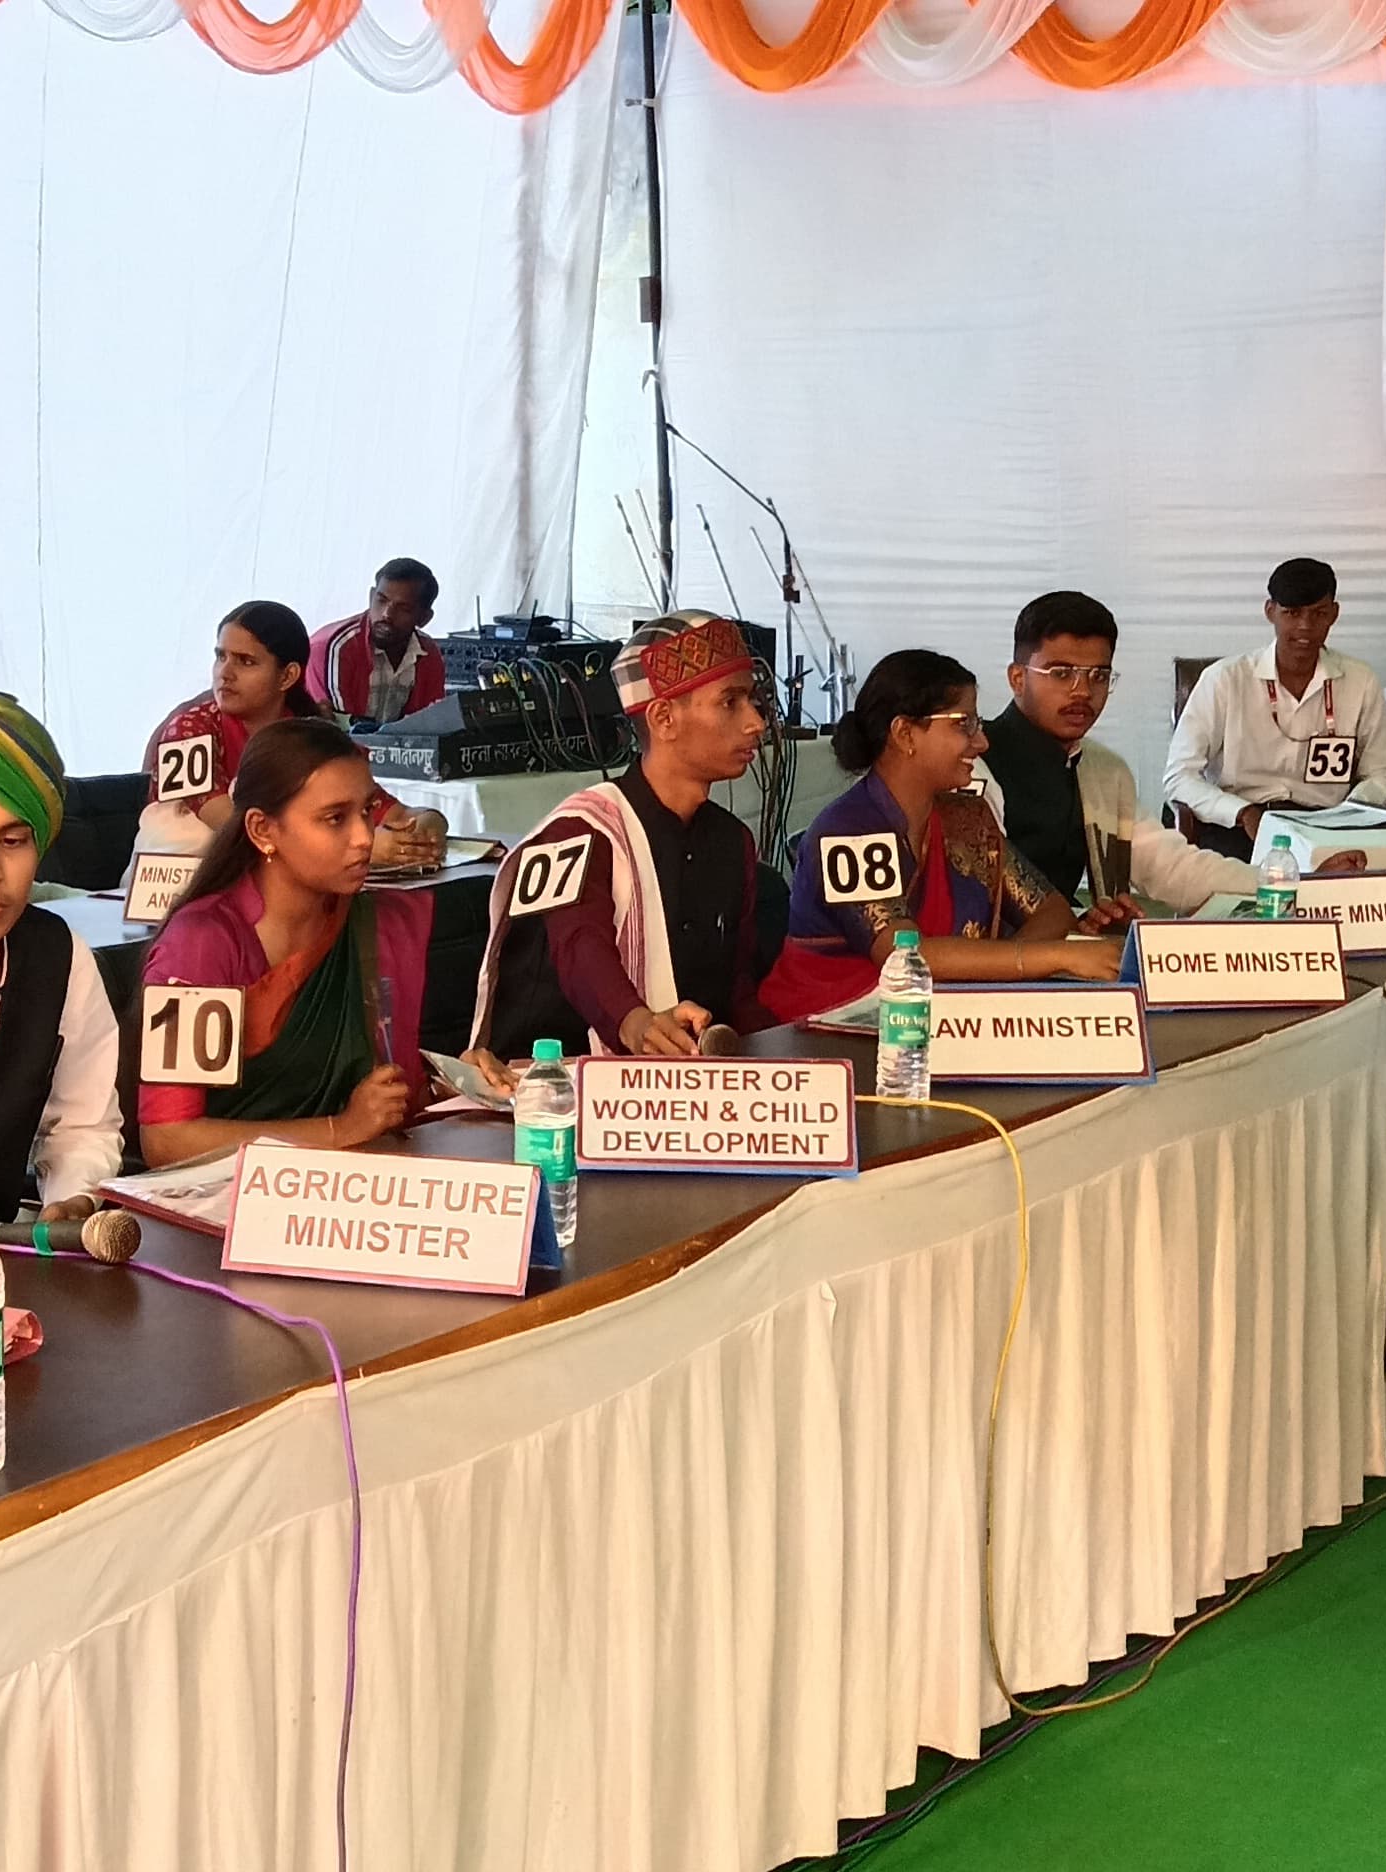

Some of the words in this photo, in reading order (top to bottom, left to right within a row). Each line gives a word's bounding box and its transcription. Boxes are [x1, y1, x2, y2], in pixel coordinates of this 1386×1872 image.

[162, 744, 208, 793] 20
[1310, 743, 1350, 777] 53
[140, 867, 193, 884] MINIST
[516, 848, 582, 906] 07
[826, 841, 895, 895] 08
[1296, 906, 1344, 923] RIME
[1148, 952, 1219, 974] HOME
[1225, 951, 1337, 973] MINISTER
[150, 1000, 232, 1072] 10
[930, 1017, 983, 1039] AW
[992, 1016, 1135, 1039] MINISTER
[621, 1068, 762, 1091] MINISTER
[771, 1070, 811, 1092] OF
[592, 1099, 708, 1122] WOMEN
[719, 1101, 738, 1122] &
[749, 1102, 839, 1123] CHILD
[603, 1131, 829, 1155] DEVELOPMENT
[243, 1166, 526, 1217] AGRICULTURE
[284, 1214, 471, 1260] MINISTER
